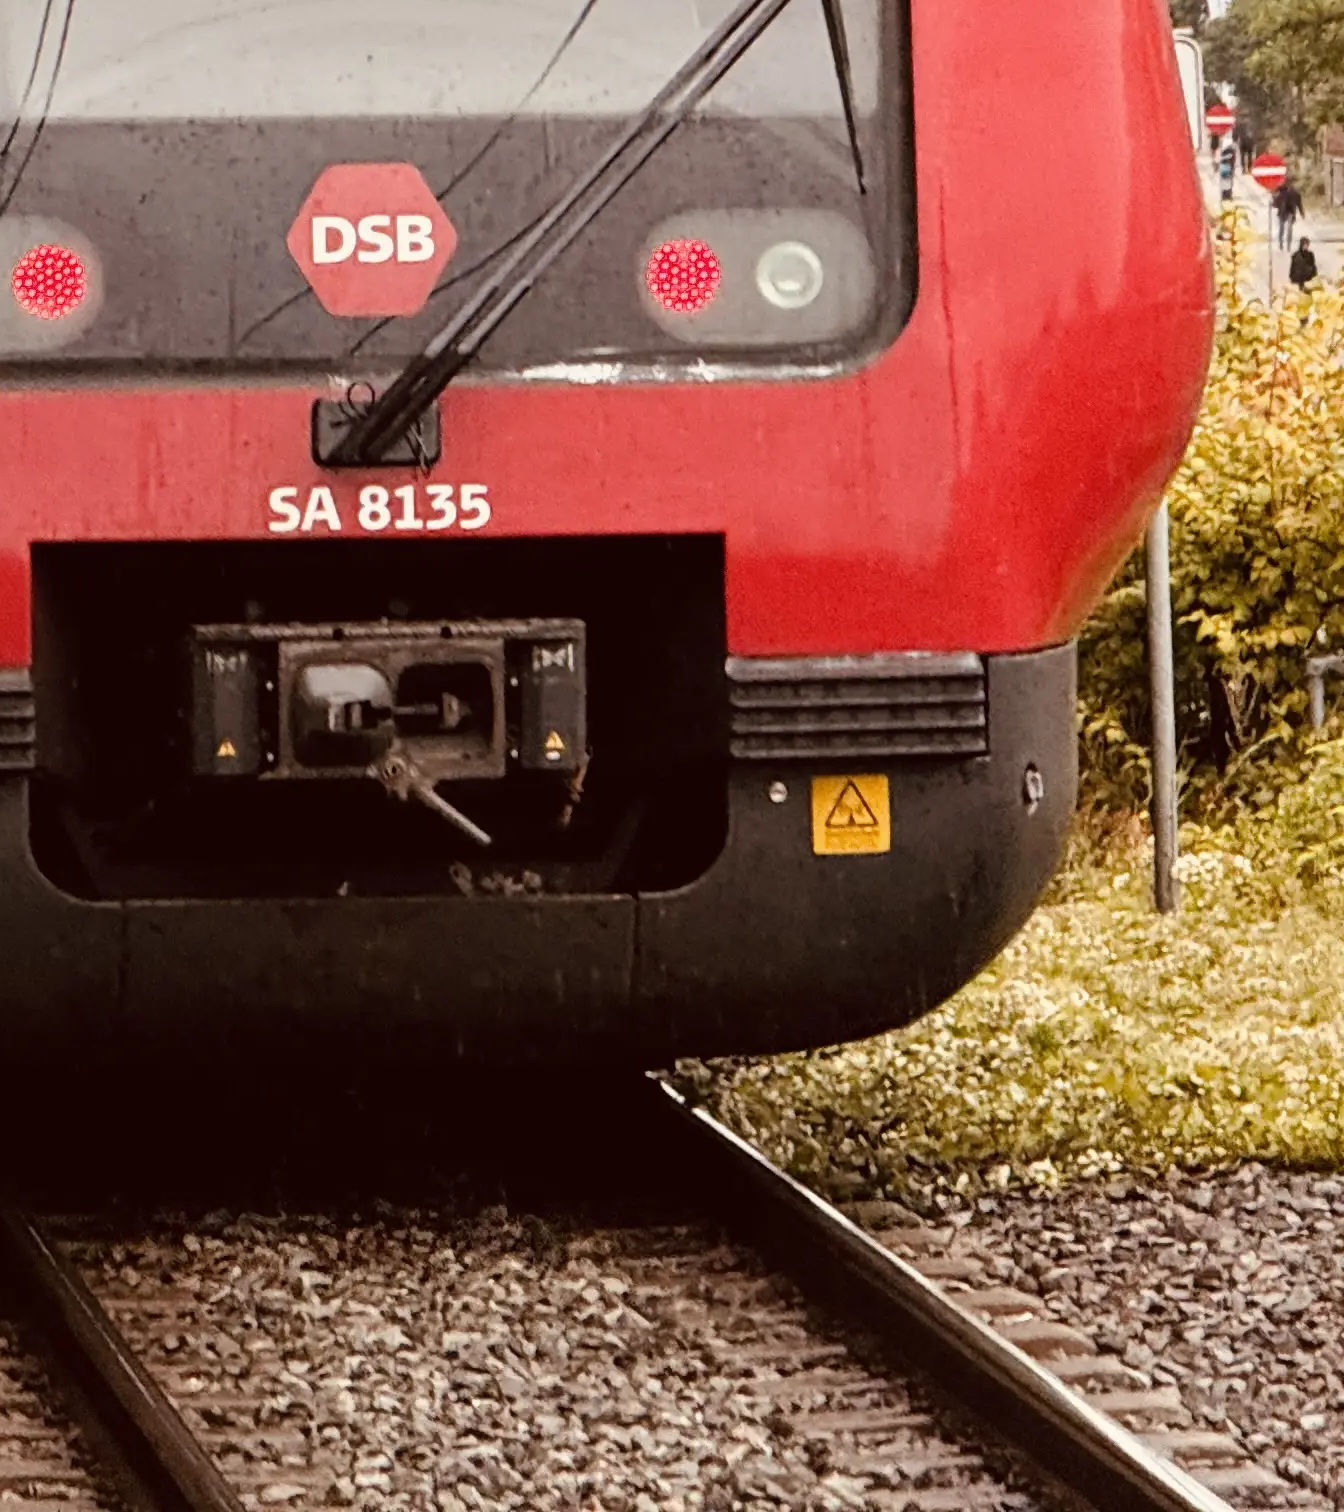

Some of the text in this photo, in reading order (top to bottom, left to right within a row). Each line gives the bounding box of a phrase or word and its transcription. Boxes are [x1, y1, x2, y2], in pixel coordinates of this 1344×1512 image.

[311, 215, 435, 264] DSB
[268, 483, 492, 532] SA 8135
